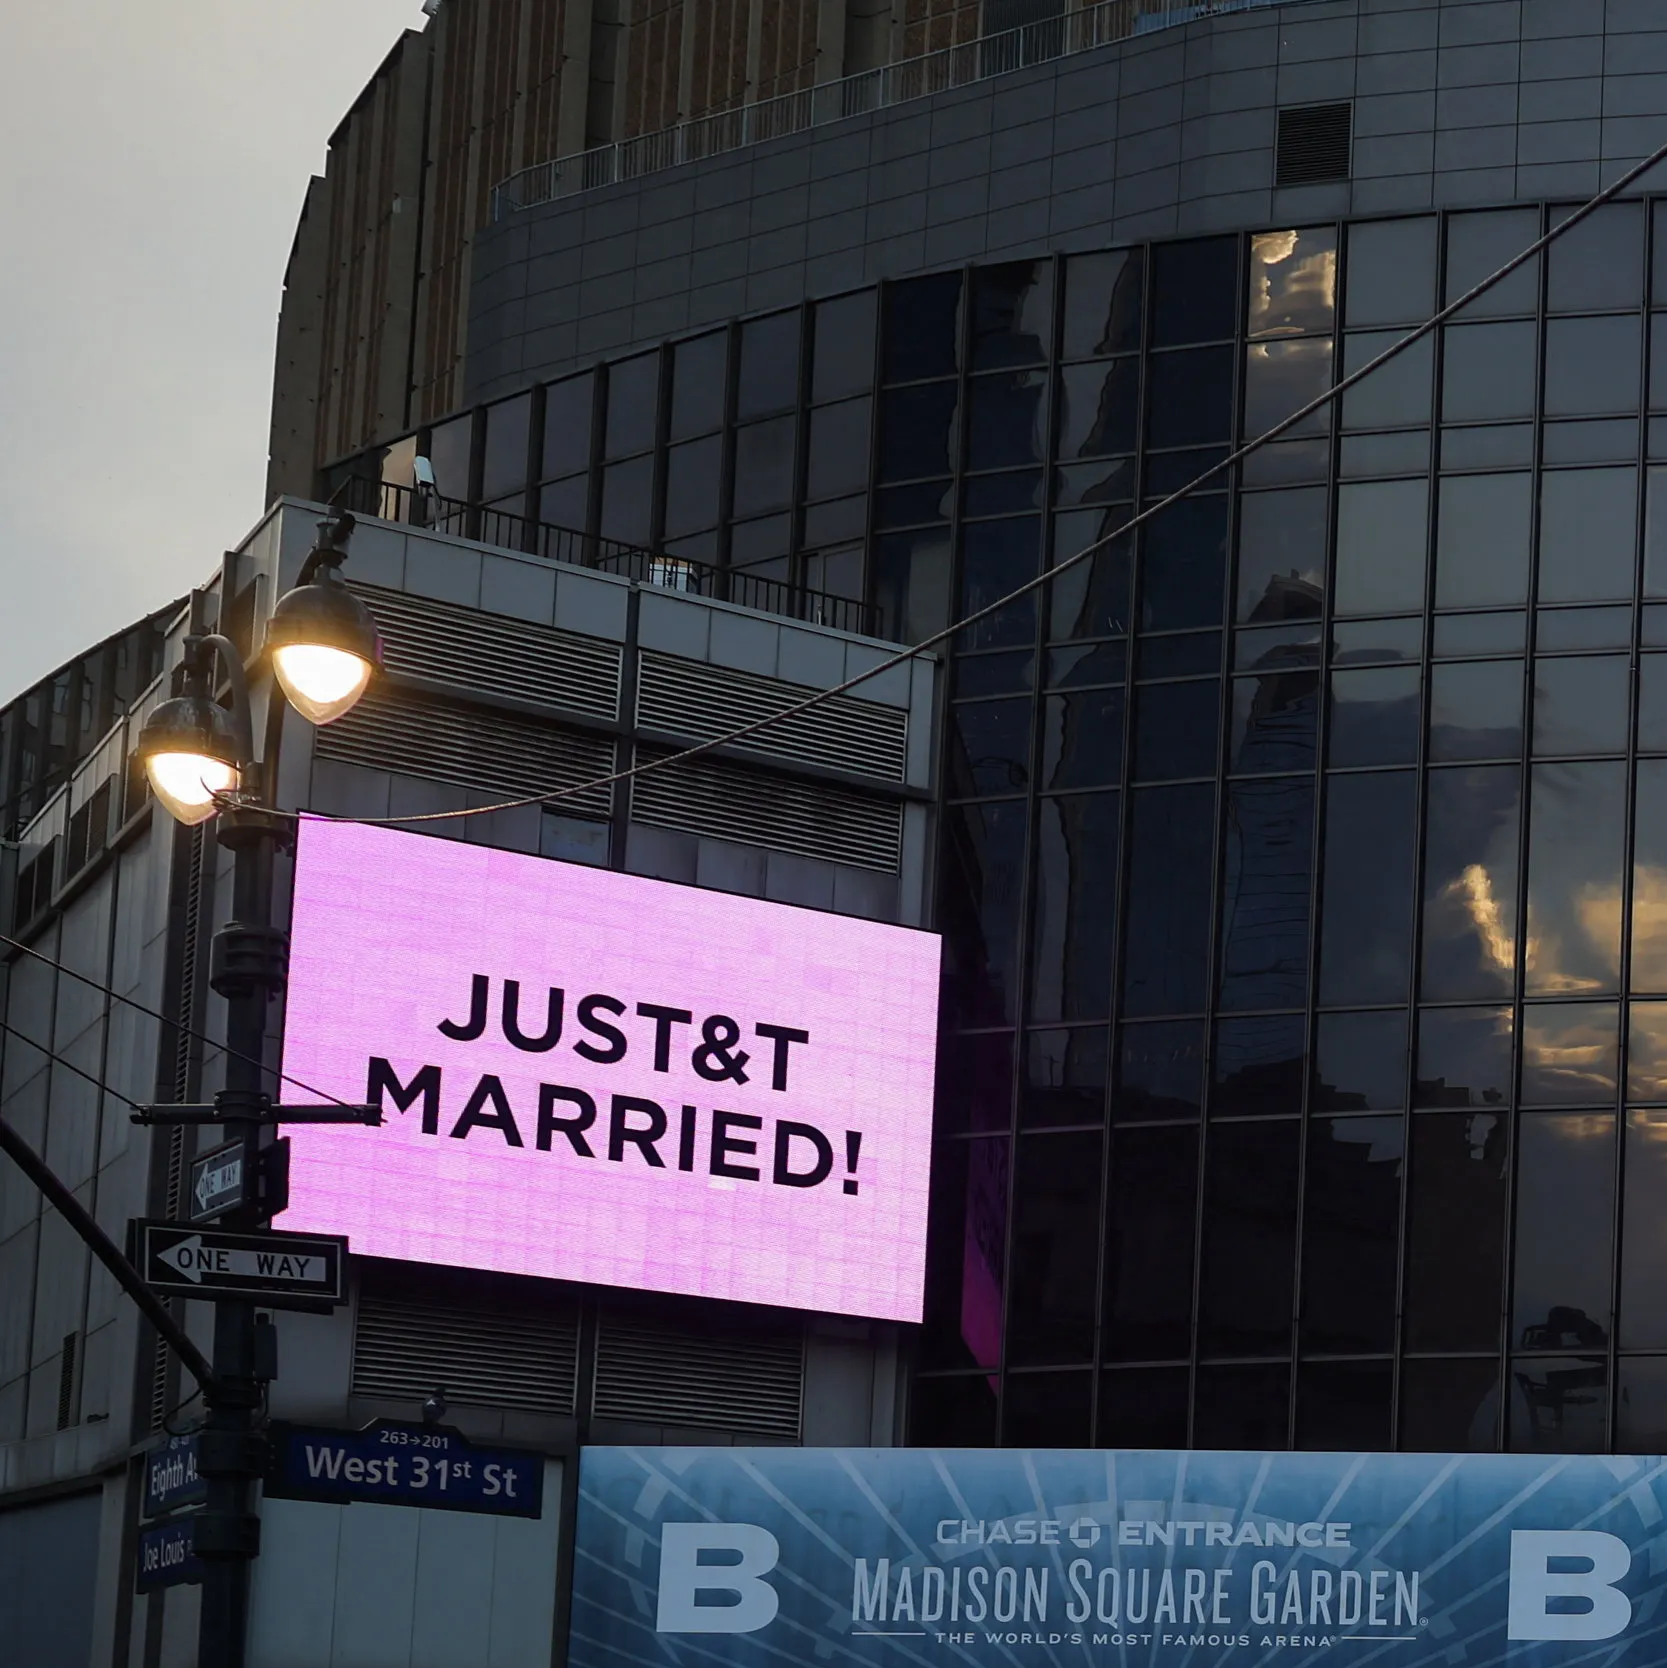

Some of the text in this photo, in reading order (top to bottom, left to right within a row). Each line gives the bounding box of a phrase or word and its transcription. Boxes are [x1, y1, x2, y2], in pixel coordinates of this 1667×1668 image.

[437, 973, 809, 1092] JUST&T
[366, 1056, 863, 1196] MARRIED!
[199, 1162, 237, 1199] ONE WAY
[177, 1247, 310, 1278] ONE WAY
[151, 1454, 183, 1501] Eighth
[304, 1444, 518, 1498] West 31st St
[143, 1541, 158, 1573] Joe
[160, 1531, 184, 1568] Louis
[936, 1519, 1352, 1549] CHASE ENTRANCE
[656, 1522, 780, 1633] B
[851, 1557, 1049, 1623] MADISON
[1066, 1557, 1234, 1630] SQUARE
[1507, 1529, 1632, 1641] B
[935, 1632, 980, 1645] THE
[986, 1632, 1081, 1646] WORLD'S
[1093, 1633, 1151, 1646] MOST
[1162, 1634, 1251, 1647] FAMOUS
